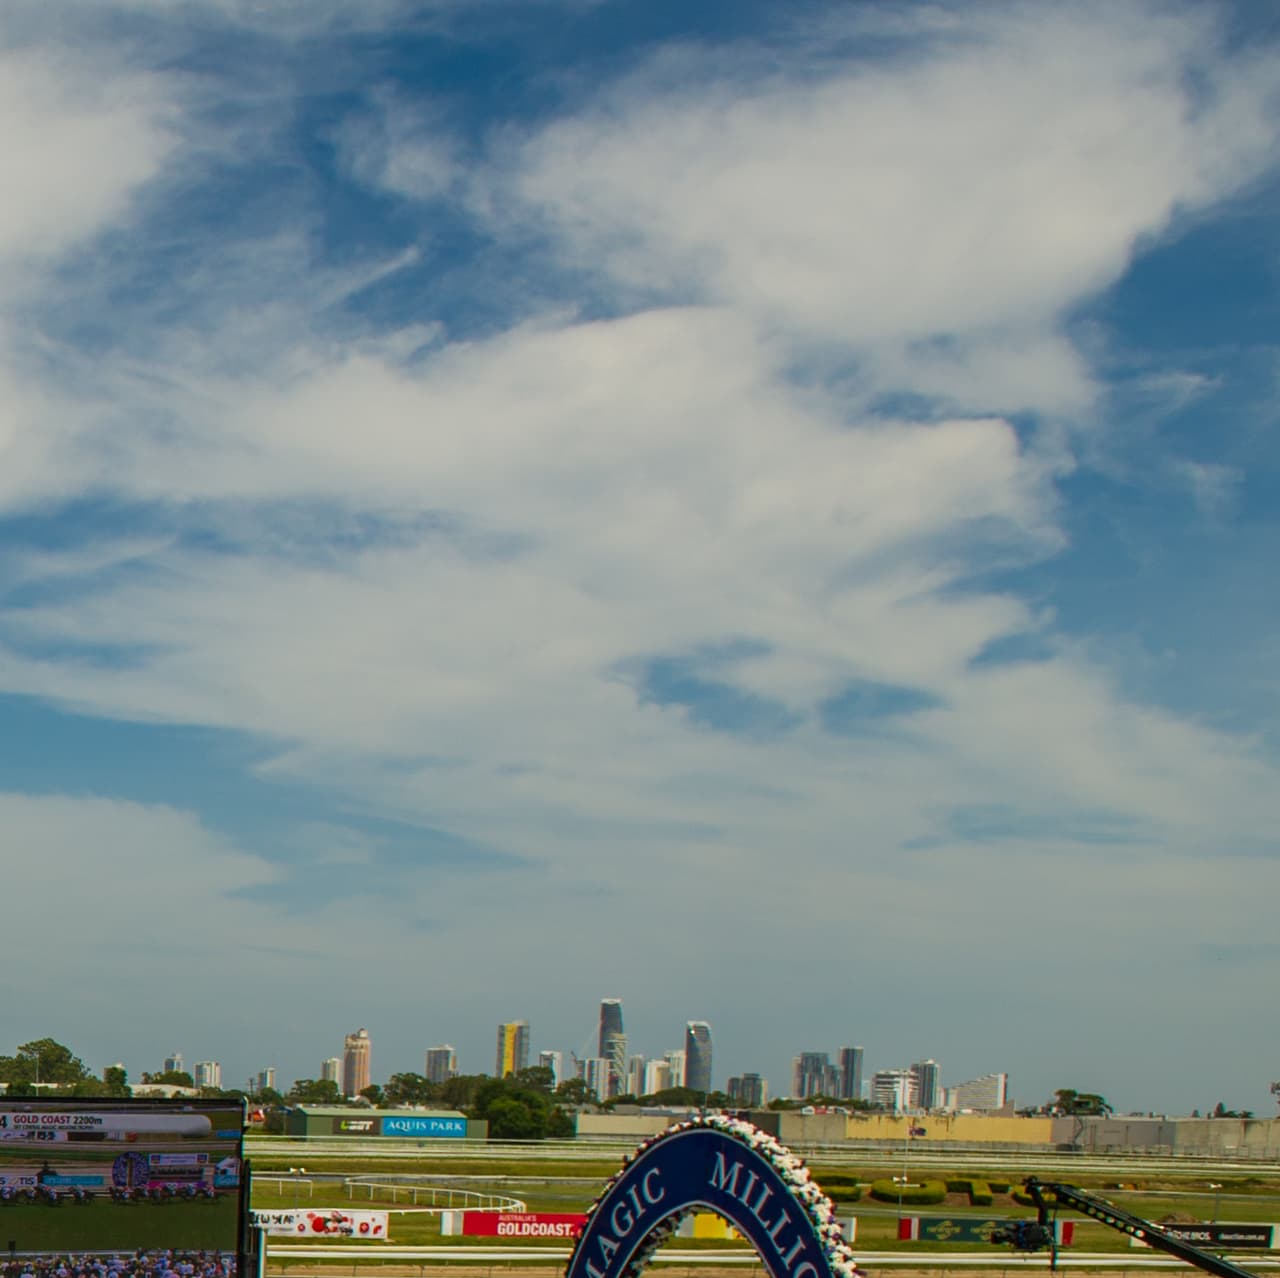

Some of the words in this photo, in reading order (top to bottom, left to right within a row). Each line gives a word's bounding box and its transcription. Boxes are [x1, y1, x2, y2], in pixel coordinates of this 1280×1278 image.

[13, 1115, 38, 1124] GOLD
[41, 1115, 70, 1124] COAST
[388, 1121, 427, 1132] AQUIS
[431, 1121, 462, 1131] PARK
[497, 1222, 575, 1236] GOLDCOAST.
